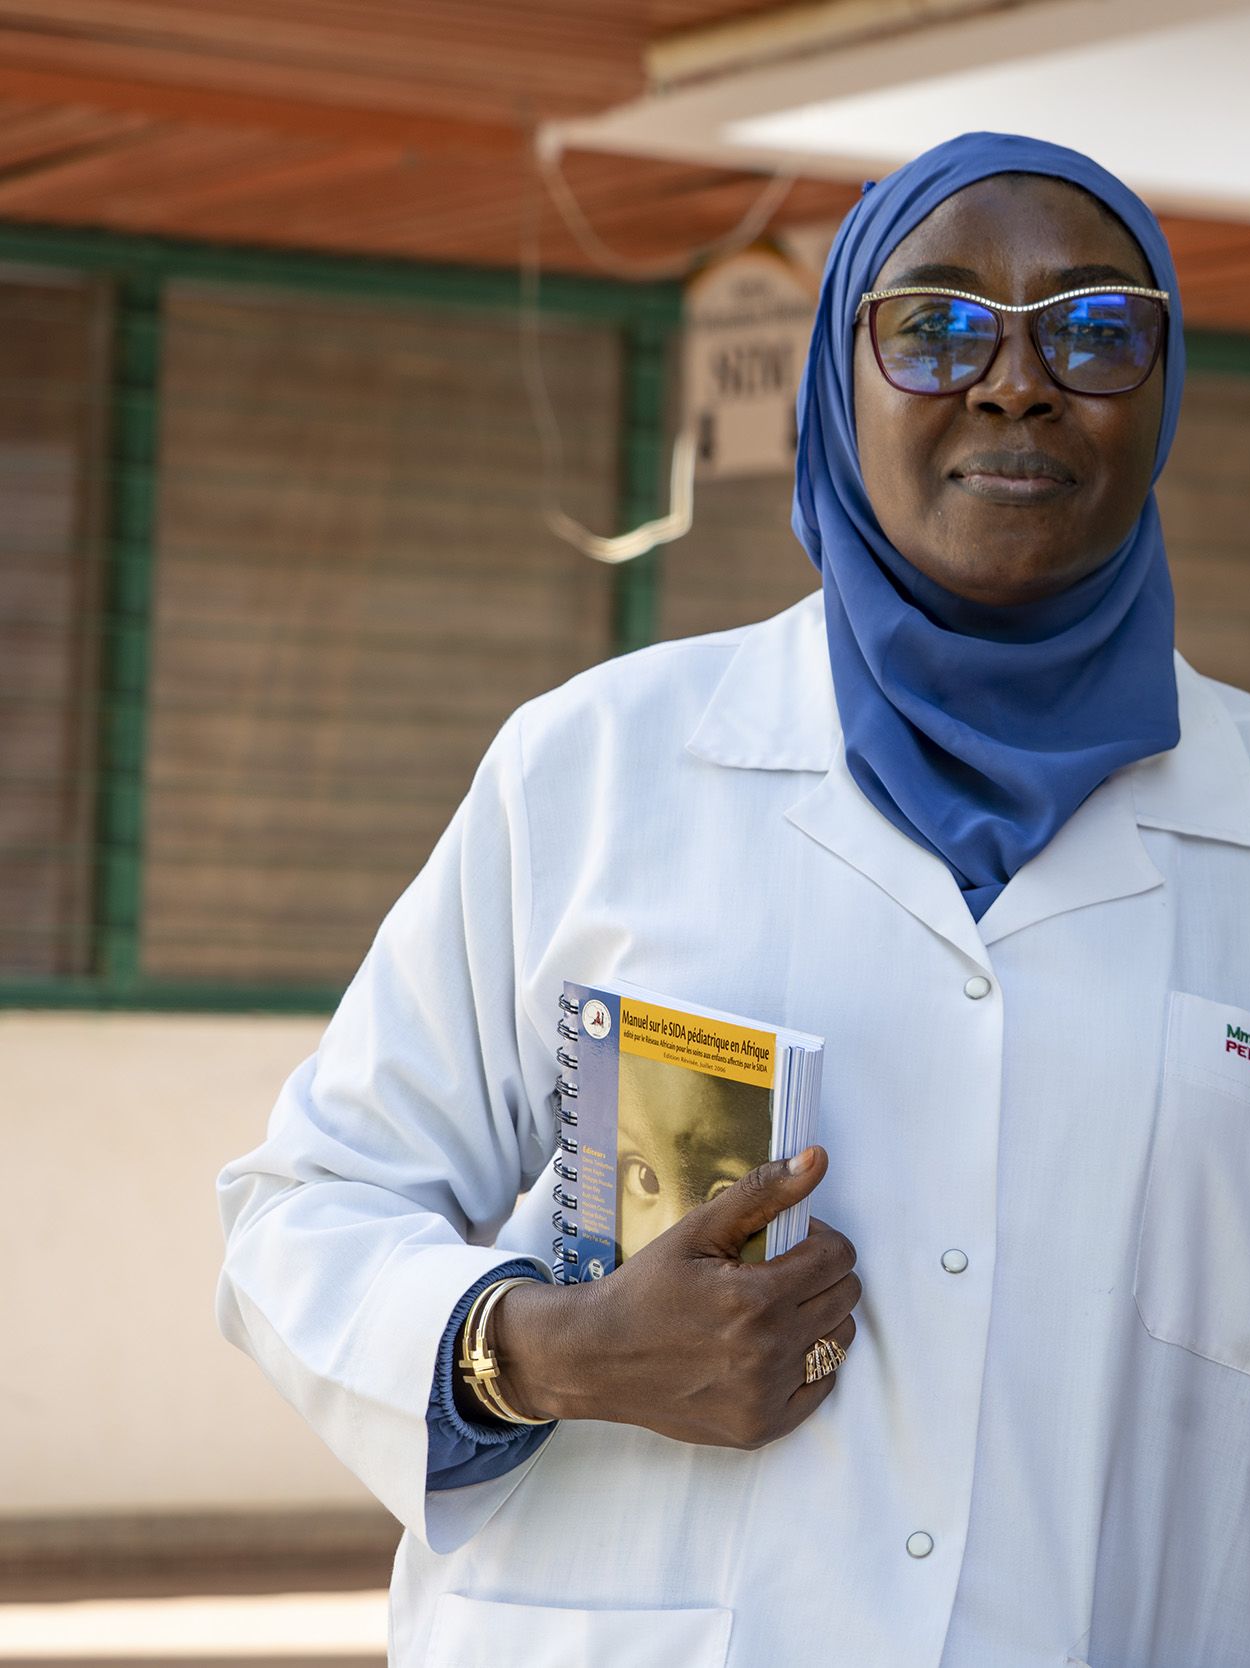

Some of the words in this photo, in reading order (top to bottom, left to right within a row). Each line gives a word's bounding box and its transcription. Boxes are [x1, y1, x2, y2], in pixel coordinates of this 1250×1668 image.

[622, 1009, 648, 1030] Manuel
[649, 1020, 661, 1033] sur
[661, 1019, 668, 1035] le
[668, 1021, 686, 1040] SIDA
[687, 1027, 729, 1053] pédiatrique
[730, 1040, 740, 1053] en
[740, 1040, 769, 1062] Afrique
[660, 1039, 675, 1050] Africain
[676, 1044, 686, 1053] pour
[692, 1048, 703, 1057] soins
[711, 1053, 727, 1063] enfants
[752, 1061, 756, 1071] le
[756, 1063, 768, 1073] SIDA
